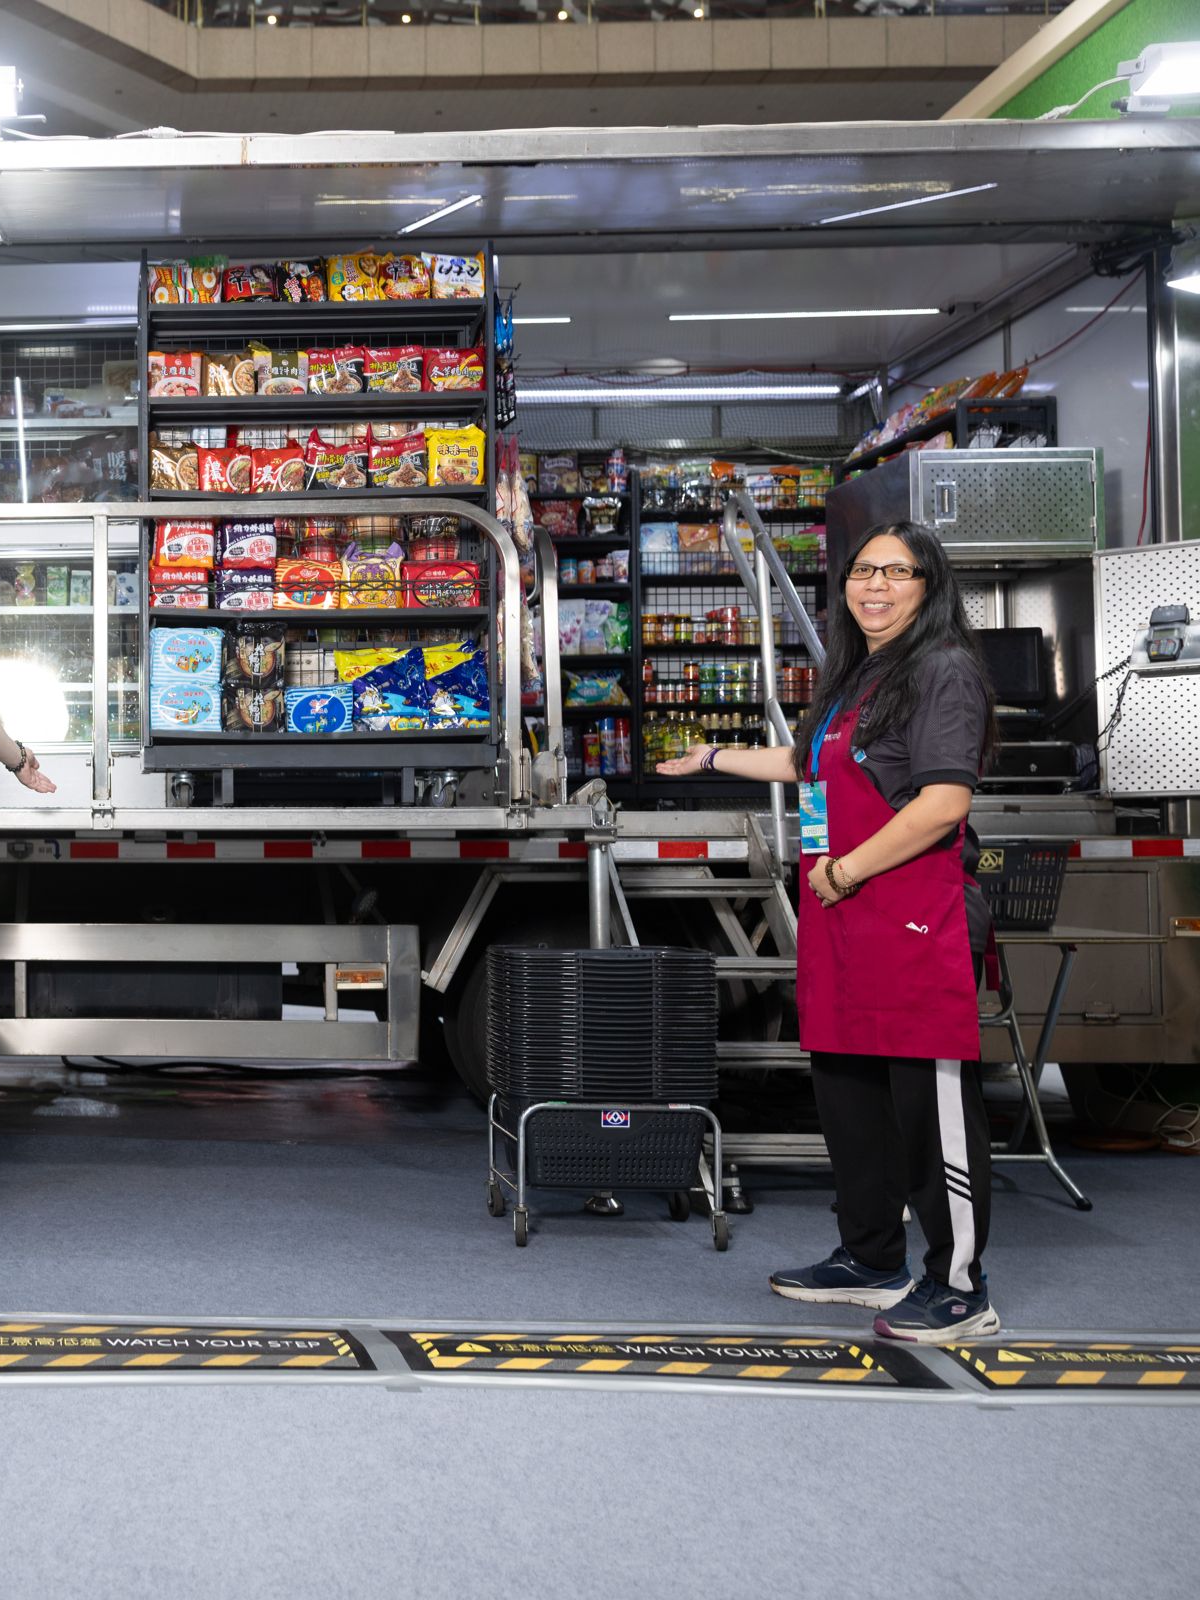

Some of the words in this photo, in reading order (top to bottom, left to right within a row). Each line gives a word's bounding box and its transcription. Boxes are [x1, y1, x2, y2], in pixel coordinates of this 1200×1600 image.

[437, 444, 479, 458] 味味一品
[106, 1338, 190, 1348] WATCH
[196, 1338, 264, 1349] YOUR
[267, 1340, 322, 1350] STEP
[616, 1344, 706, 1357] WATCH
[705, 1347, 782, 1359] YOUR
[782, 1348, 840, 1361] STEP
